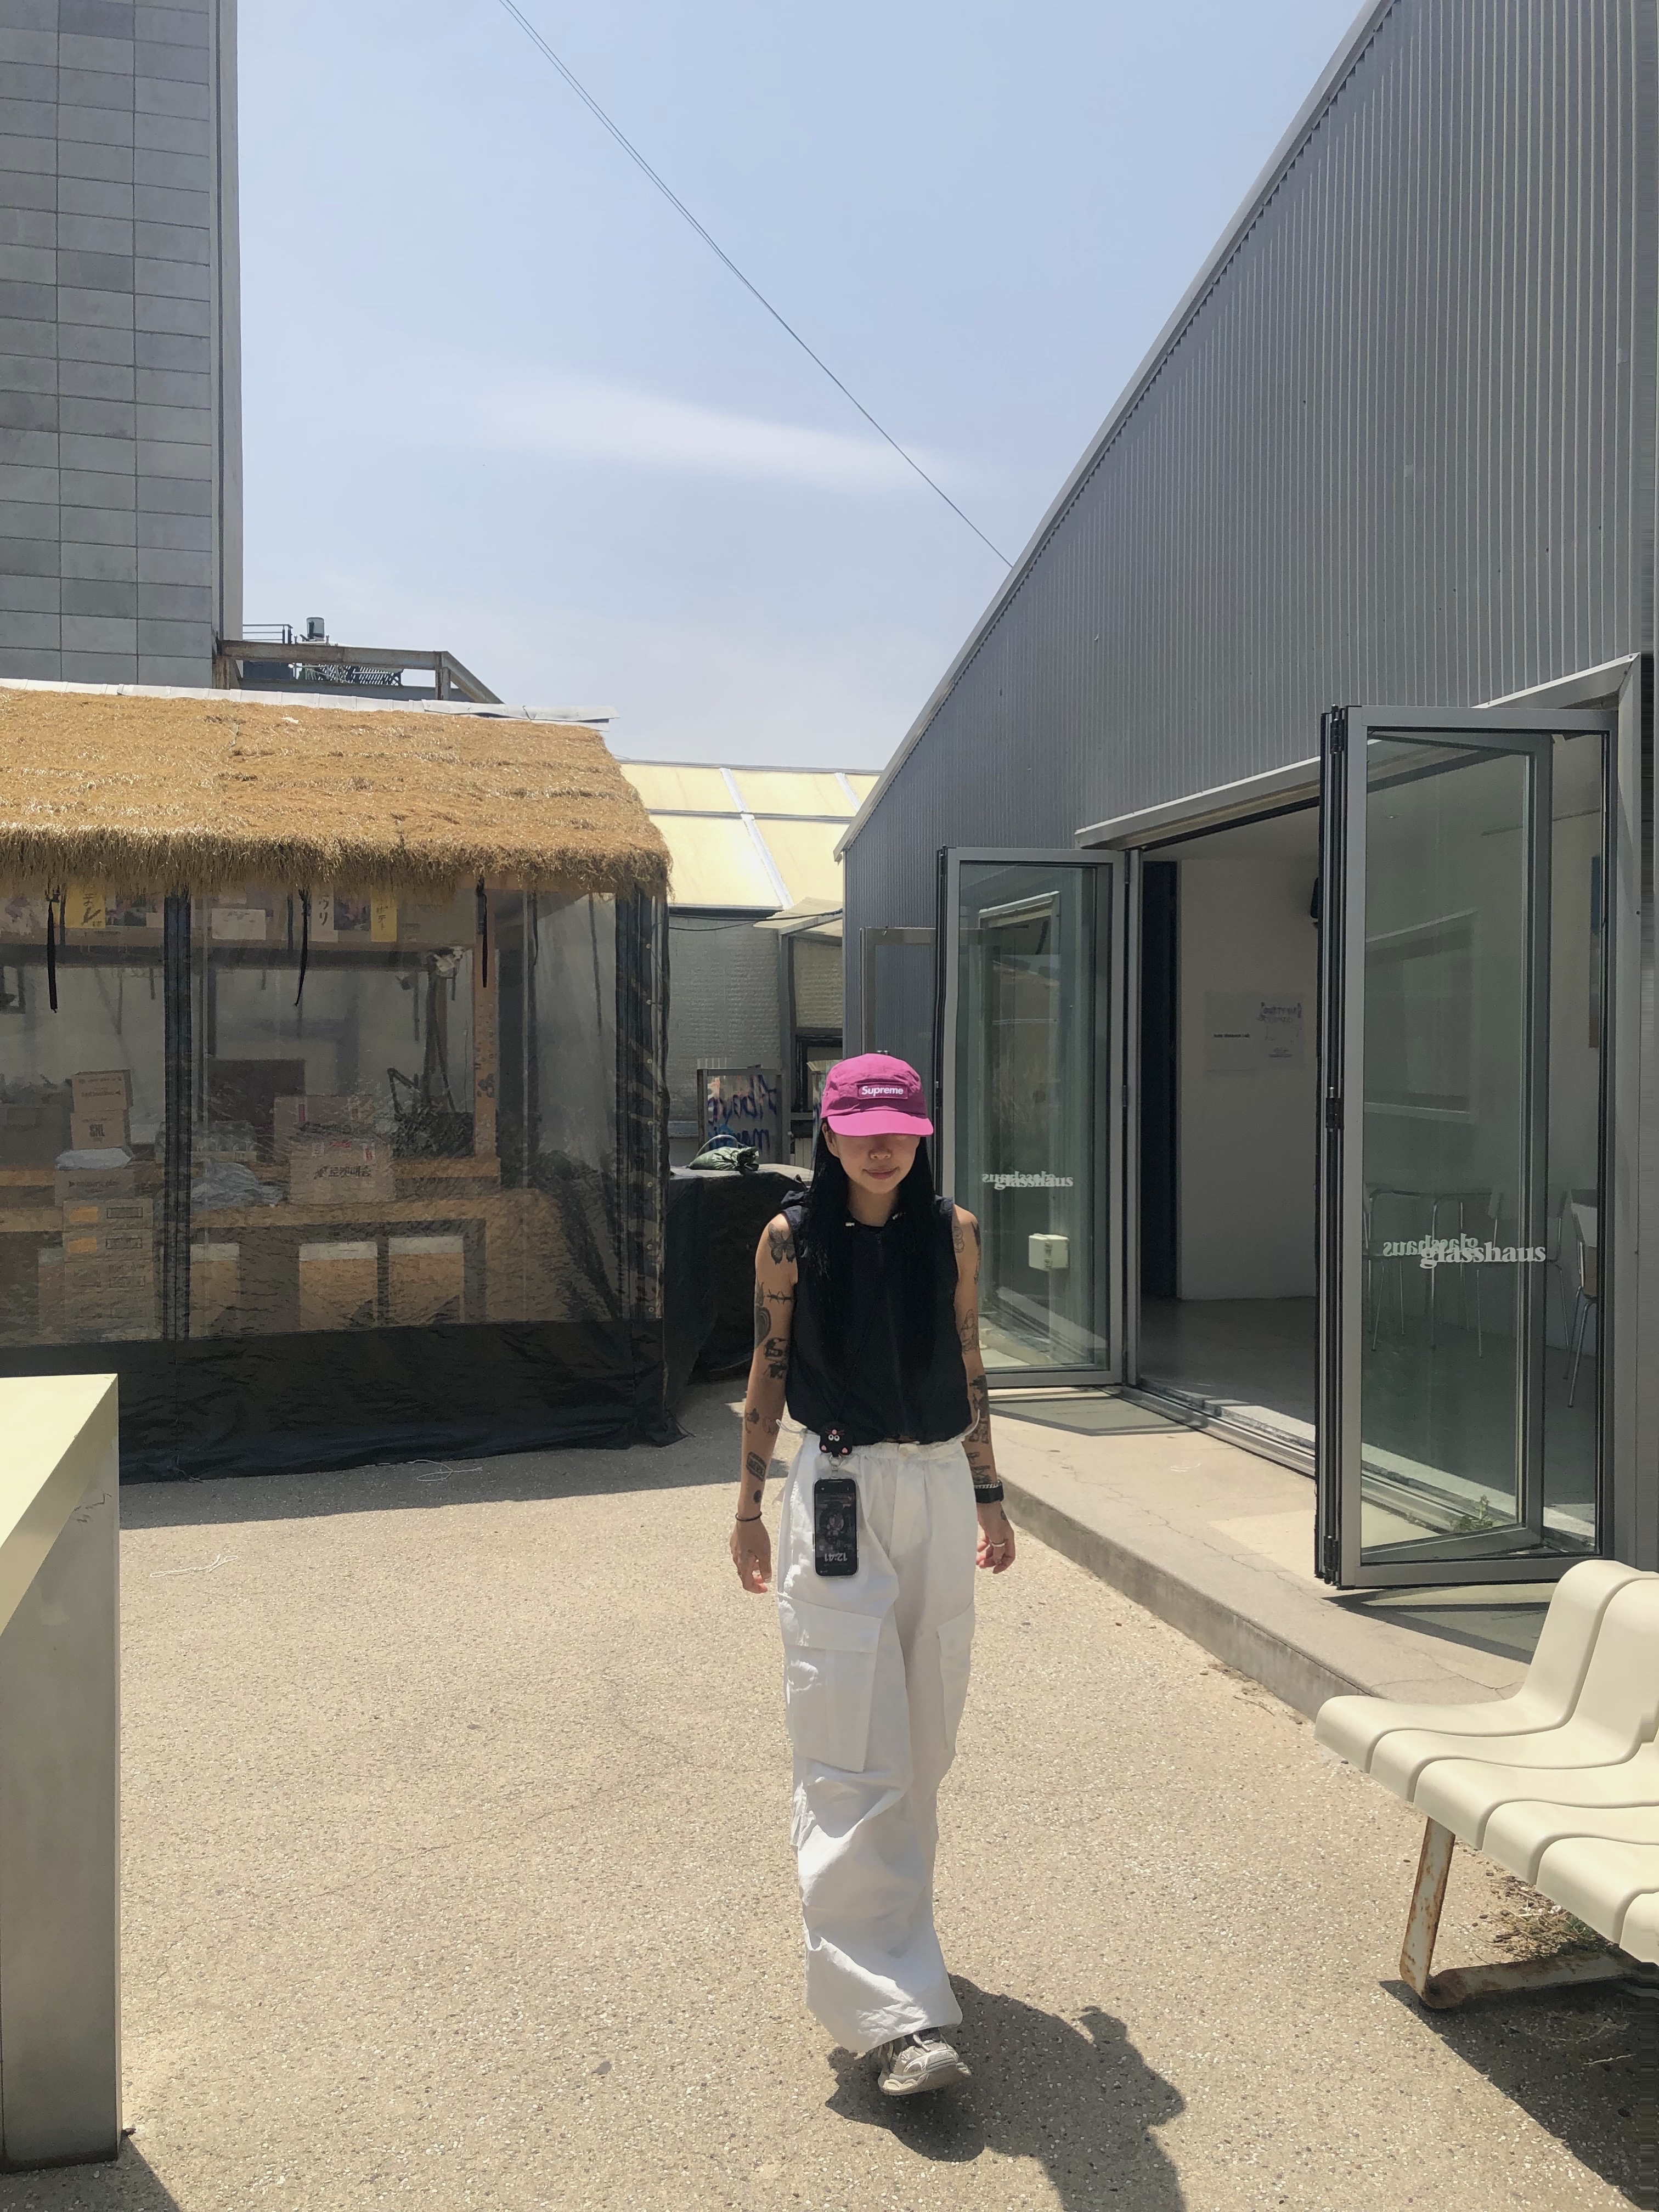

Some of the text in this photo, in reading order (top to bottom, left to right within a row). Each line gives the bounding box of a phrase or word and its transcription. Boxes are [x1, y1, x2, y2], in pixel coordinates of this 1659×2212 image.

[861, 1086, 904, 1097] Supreme
[994, 1175, 1074, 1190] glasshaus
[1420, 1242, 1547, 1269] glasshaus
[824, 1553, 848, 1562] 12:41
